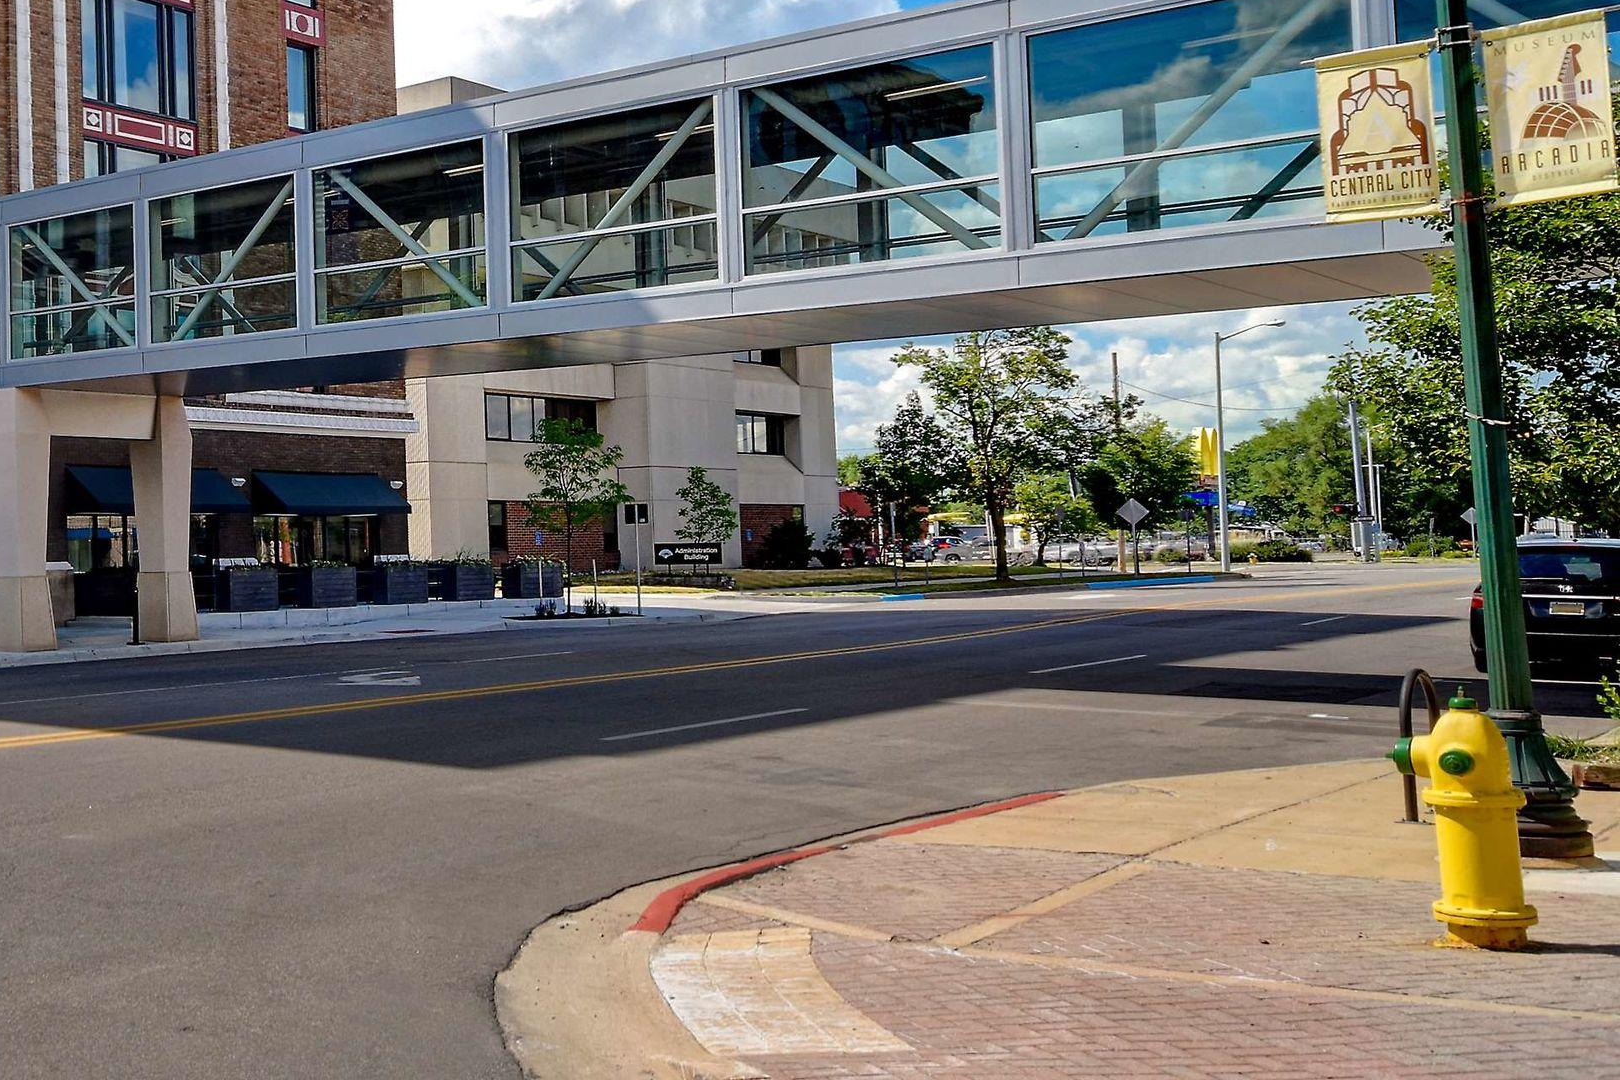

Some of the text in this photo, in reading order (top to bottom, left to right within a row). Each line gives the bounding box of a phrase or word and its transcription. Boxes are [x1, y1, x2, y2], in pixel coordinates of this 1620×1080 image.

[1493, 30, 1596, 57] MUSEUM
[1501, 139, 1610, 174] ARCADIA
[1330, 168, 1432, 198] CENTRAL CITY
